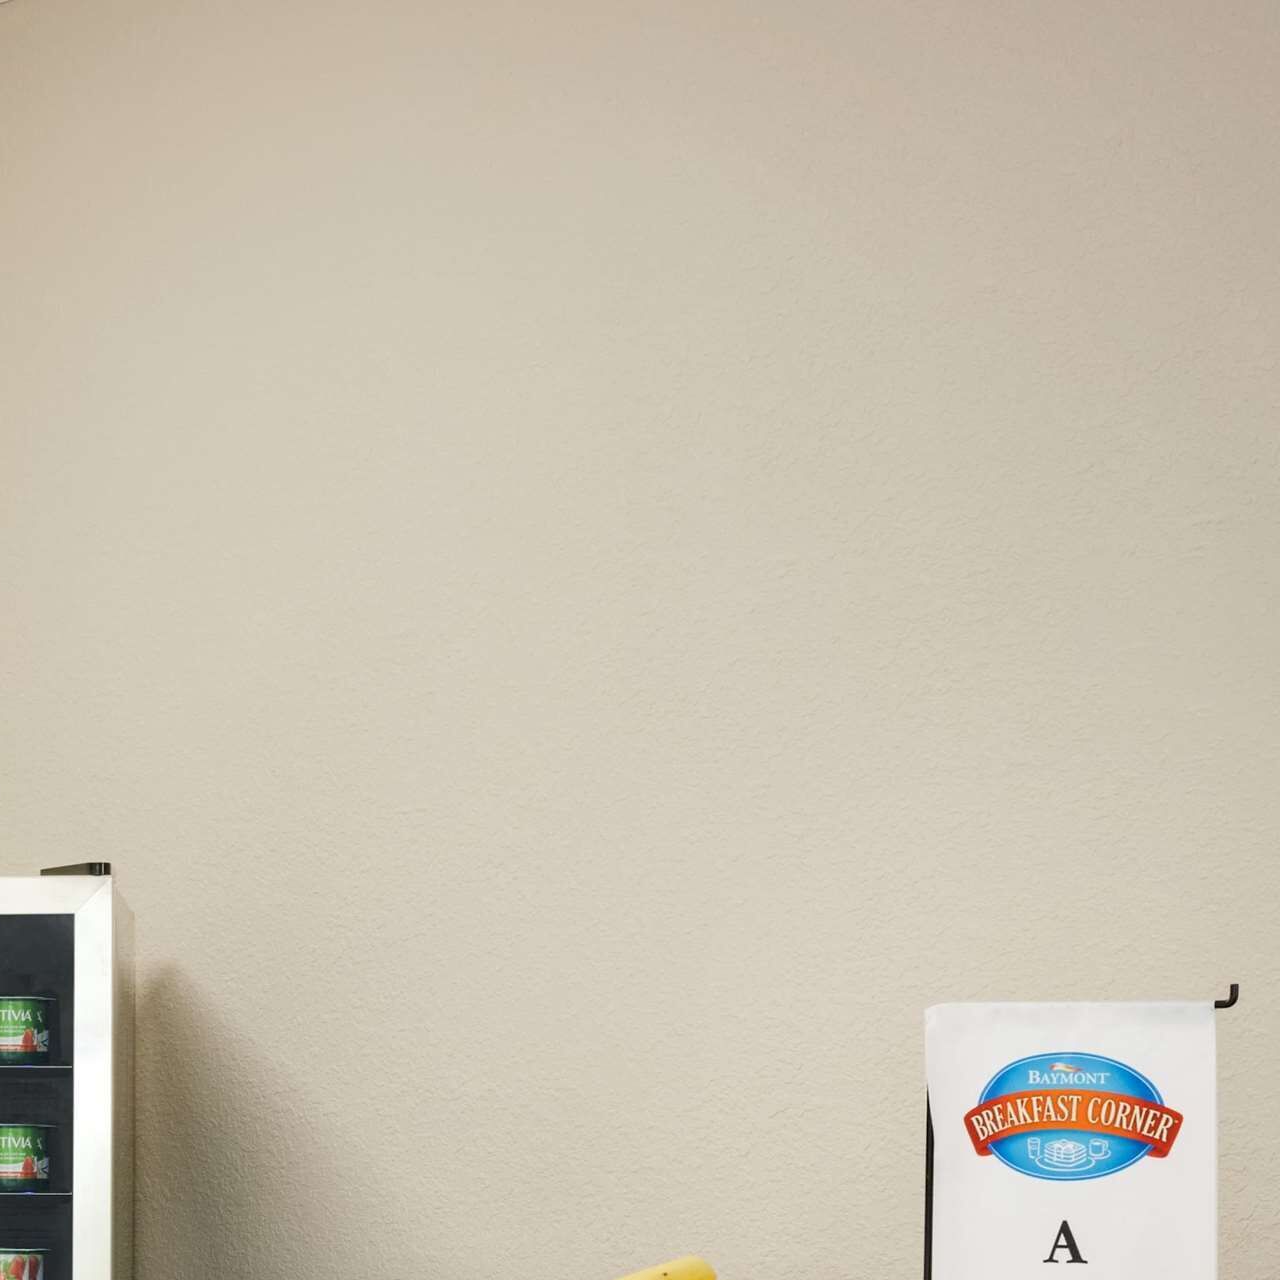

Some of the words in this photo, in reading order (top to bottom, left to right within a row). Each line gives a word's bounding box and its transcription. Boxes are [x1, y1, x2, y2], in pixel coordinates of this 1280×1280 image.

[1028, 1070, 1108, 1085] BAYMONT
[970, 1095, 1082, 1142] BREAKFAST
[1087, 1096, 1174, 1143] CORNER
[1043, 1220, 1088, 1264] A
